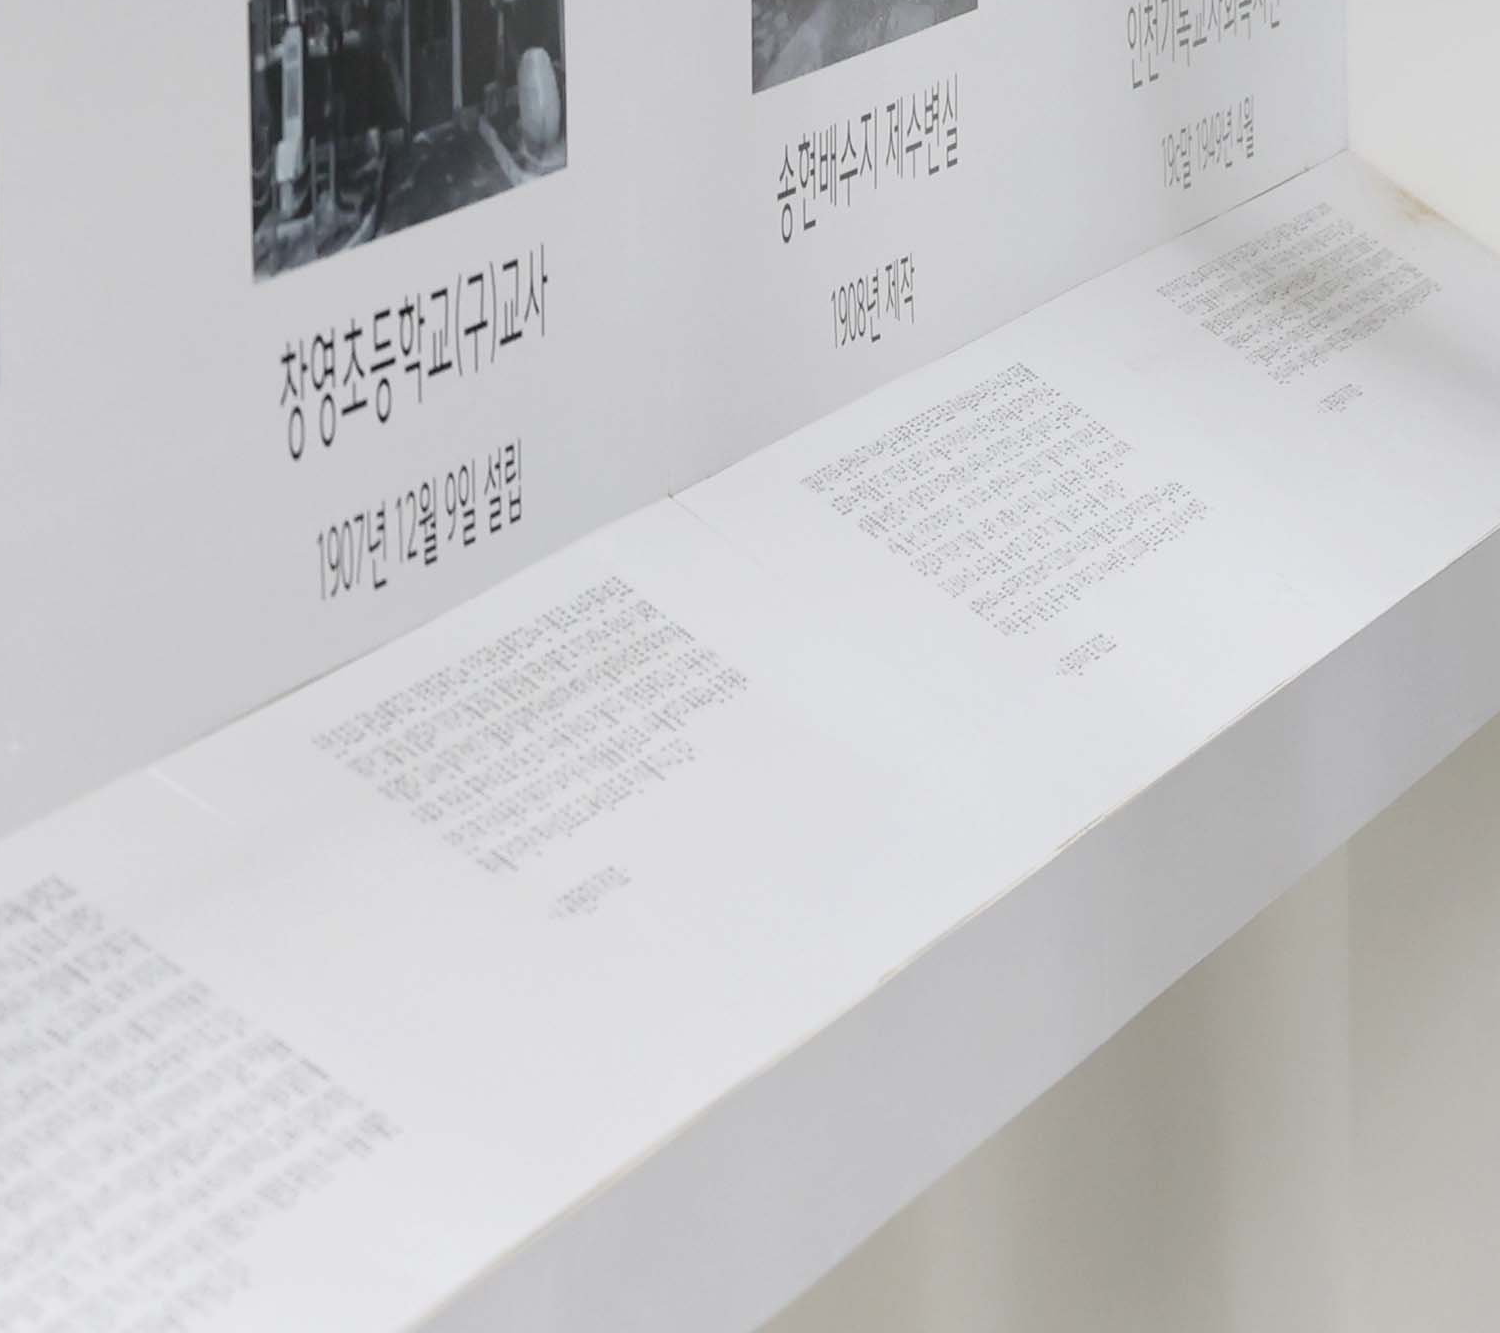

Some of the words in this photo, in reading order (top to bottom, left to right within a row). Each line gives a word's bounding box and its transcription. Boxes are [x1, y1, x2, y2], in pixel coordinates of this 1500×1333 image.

[776, 105, 878, 244] 송현배수지
[885, 72, 959, 180] 제수변실
[1236, 93, 1254, 159] 4월
[280, 242, 549, 462] 창영초등학교(구)교사
[831, 268, 882, 350] 1908년
[884, 252, 915, 325] 제작
[316, 499, 388, 601] 1907년
[395, 476, 438, 566] 12월
[444, 458, 477, 547] 9일
[483, 438, 522, 534] 설립
